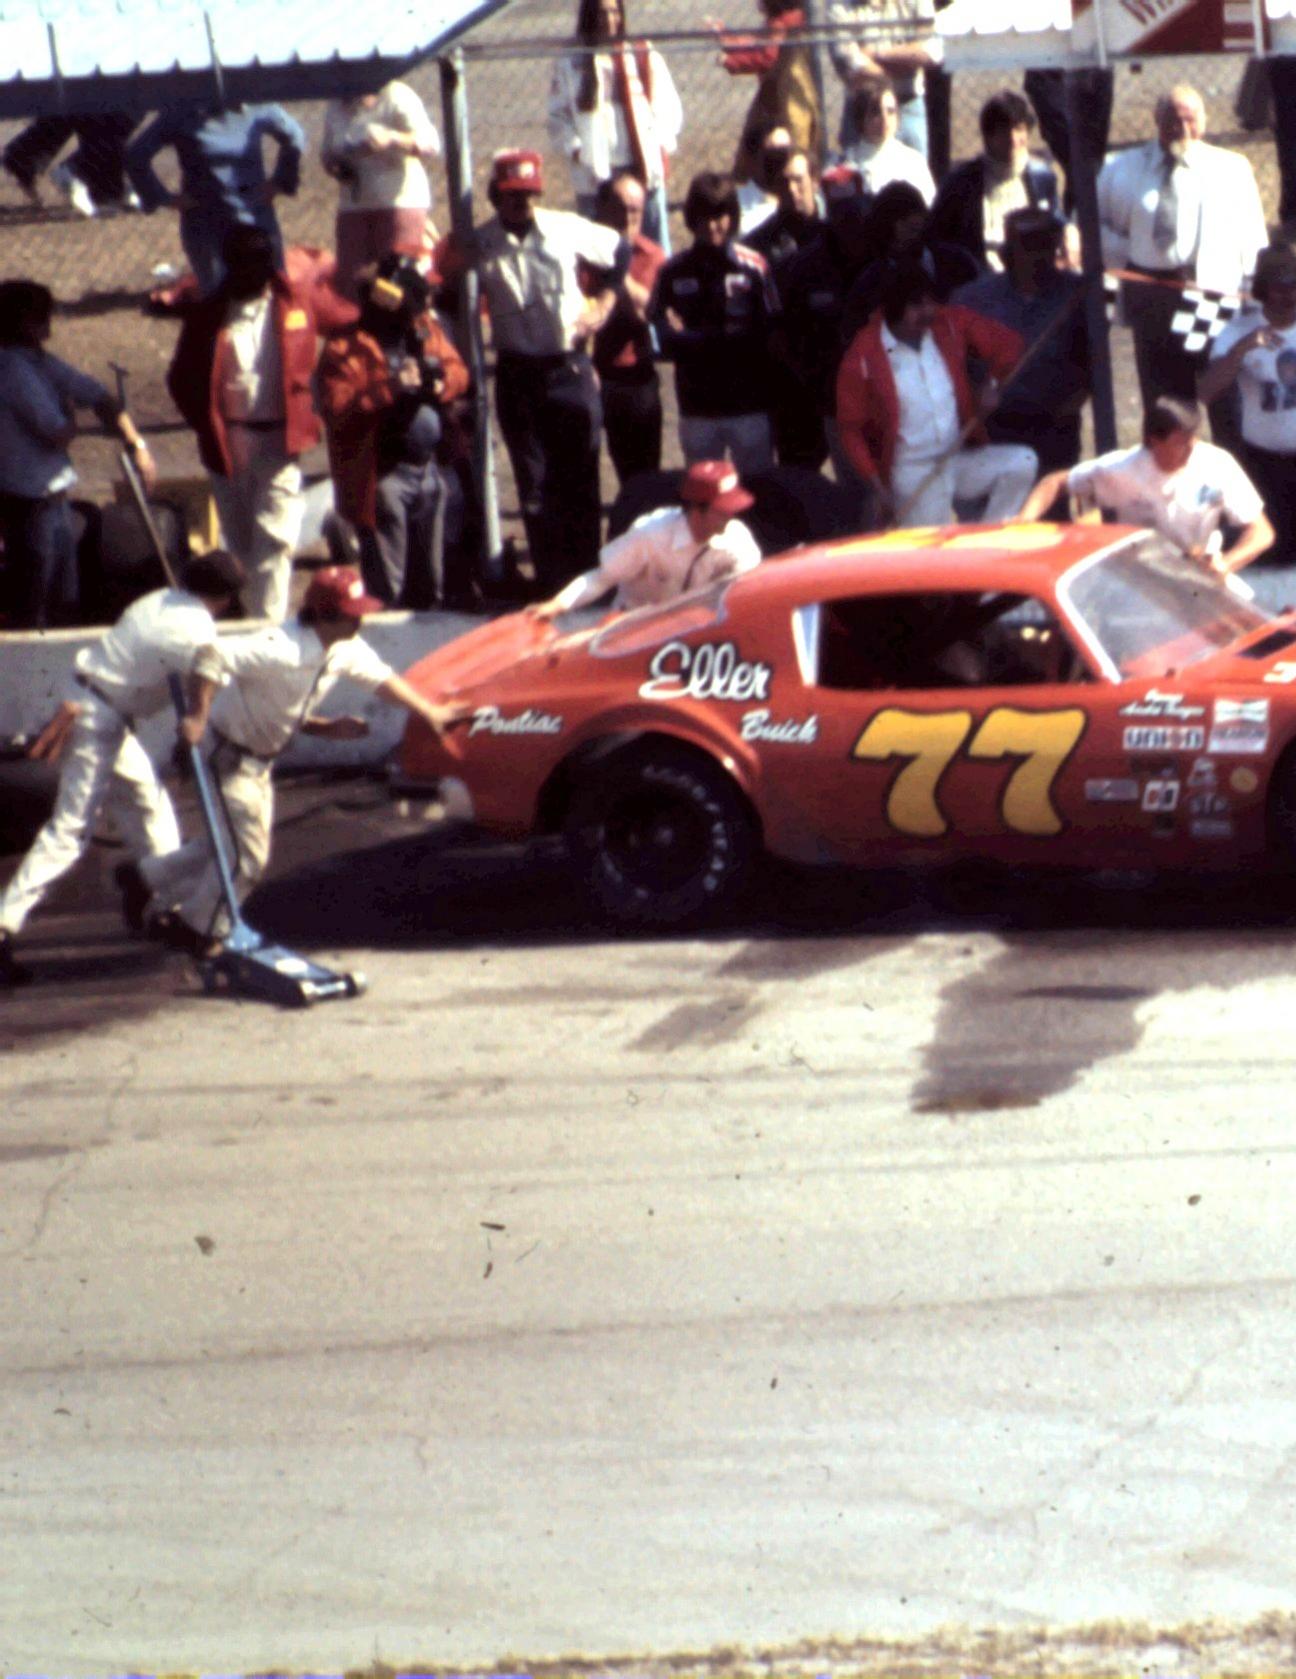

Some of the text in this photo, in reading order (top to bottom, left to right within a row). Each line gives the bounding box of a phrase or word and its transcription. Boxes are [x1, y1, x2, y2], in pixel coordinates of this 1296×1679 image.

[638, 641, 770, 700] Eller
[467, 705, 563, 738] Pontiac
[740, 708, 818, 743] Buick
[851, 705, 1087, 837] 77
